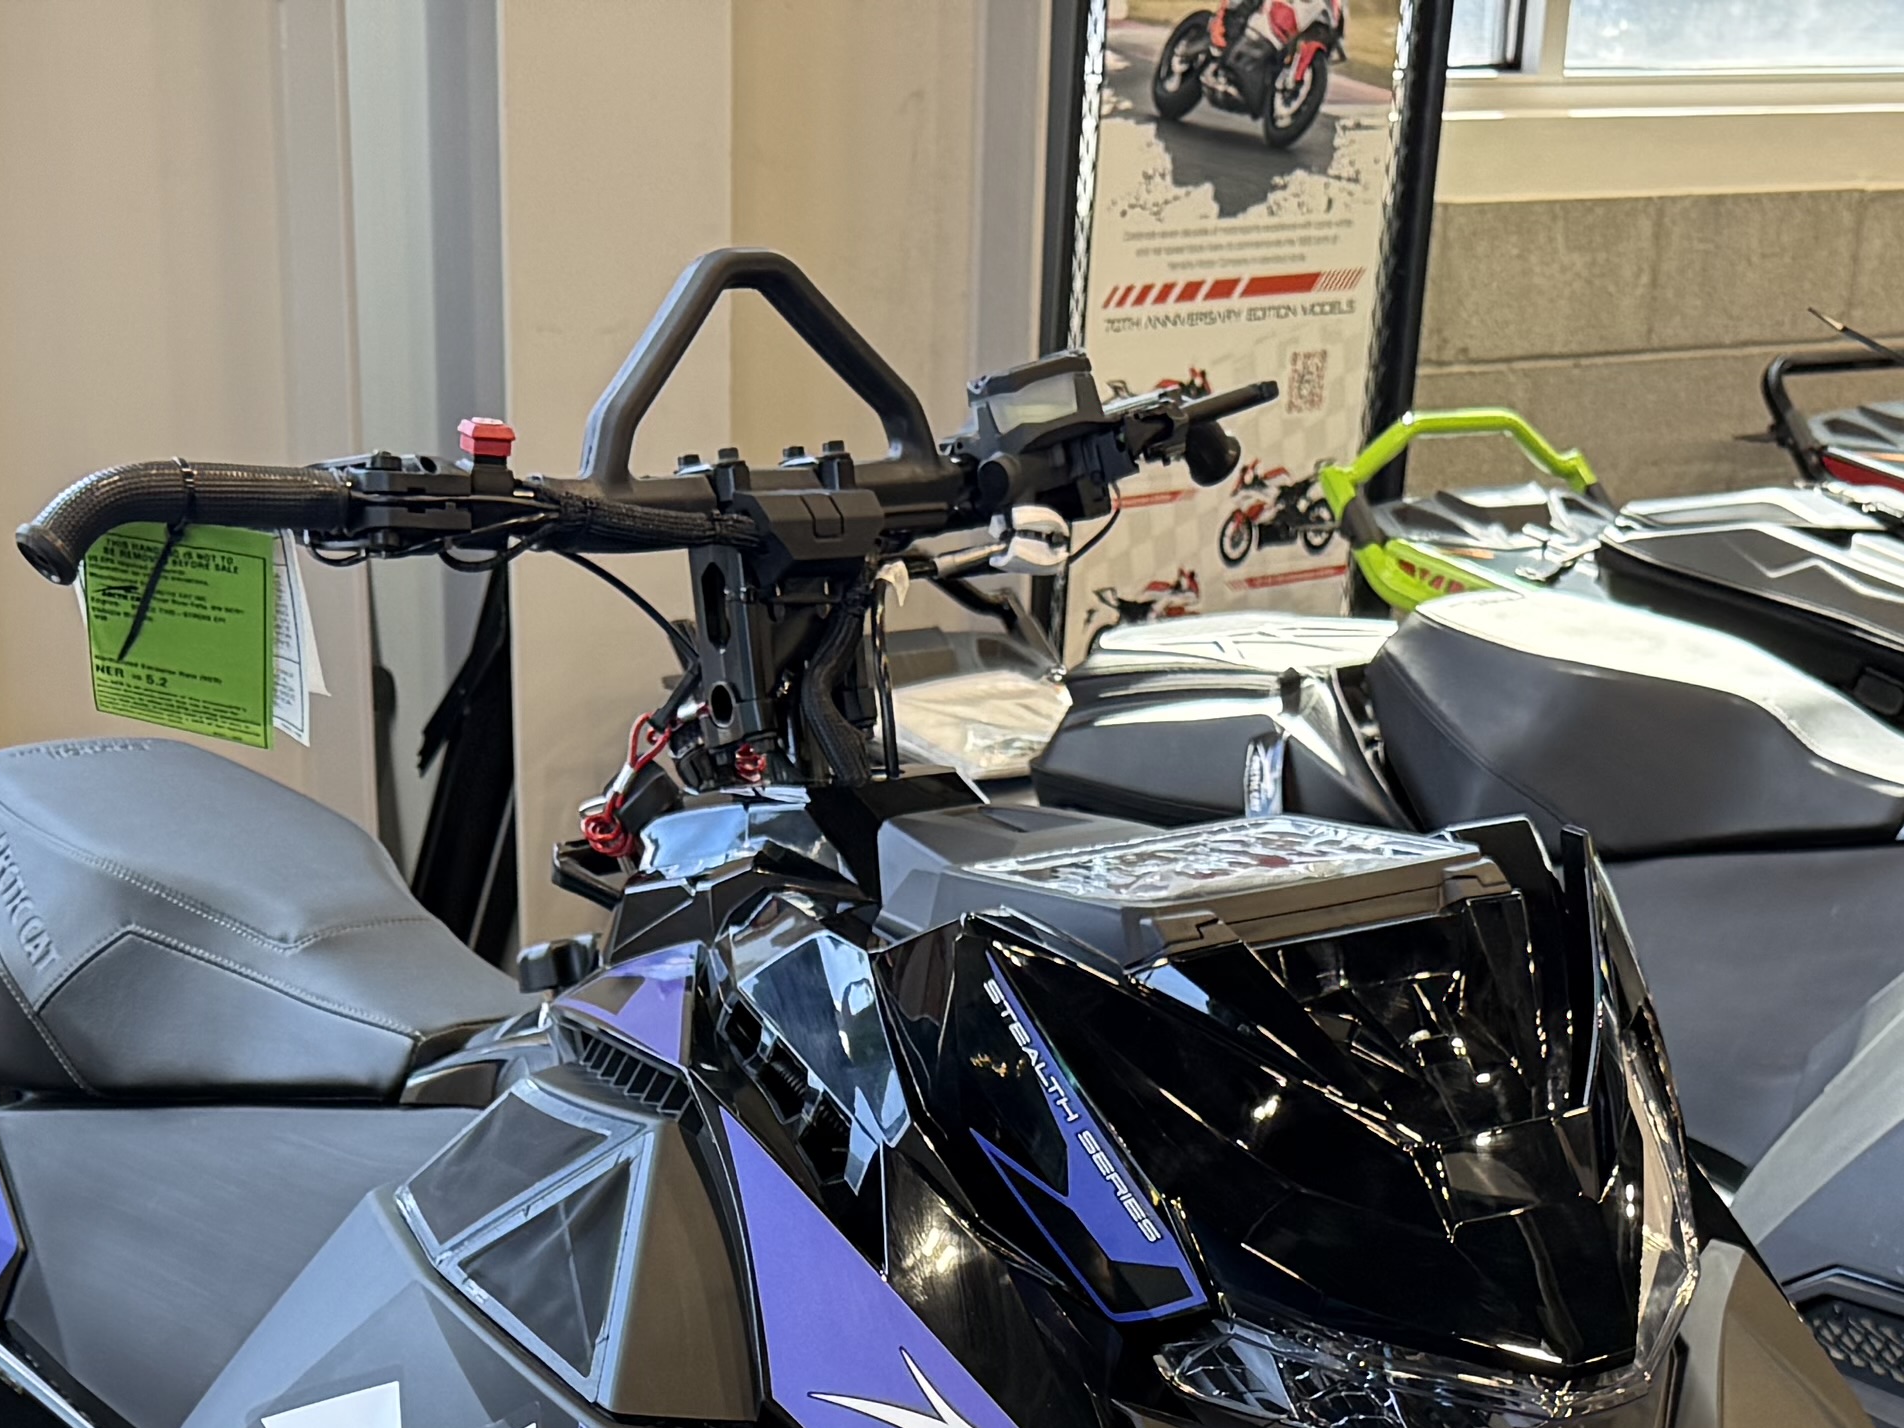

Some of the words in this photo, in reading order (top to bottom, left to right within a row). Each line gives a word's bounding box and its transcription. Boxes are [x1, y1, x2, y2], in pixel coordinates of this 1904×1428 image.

[1144, 309, 1242, 330] ANNIVERSARY
[1247, 304, 1296, 322] EDITION
[1300, 299, 1356, 317] MODELS
[221, 556, 234, 565] TO
[96, 664, 124, 678] NER
[146, 675, 168, 688] 5.2
[16, 914, 60, 972] CAT
[983, 979, 1080, 1123] STEALTH
[1077, 1130, 1162, 1243] SERIES
